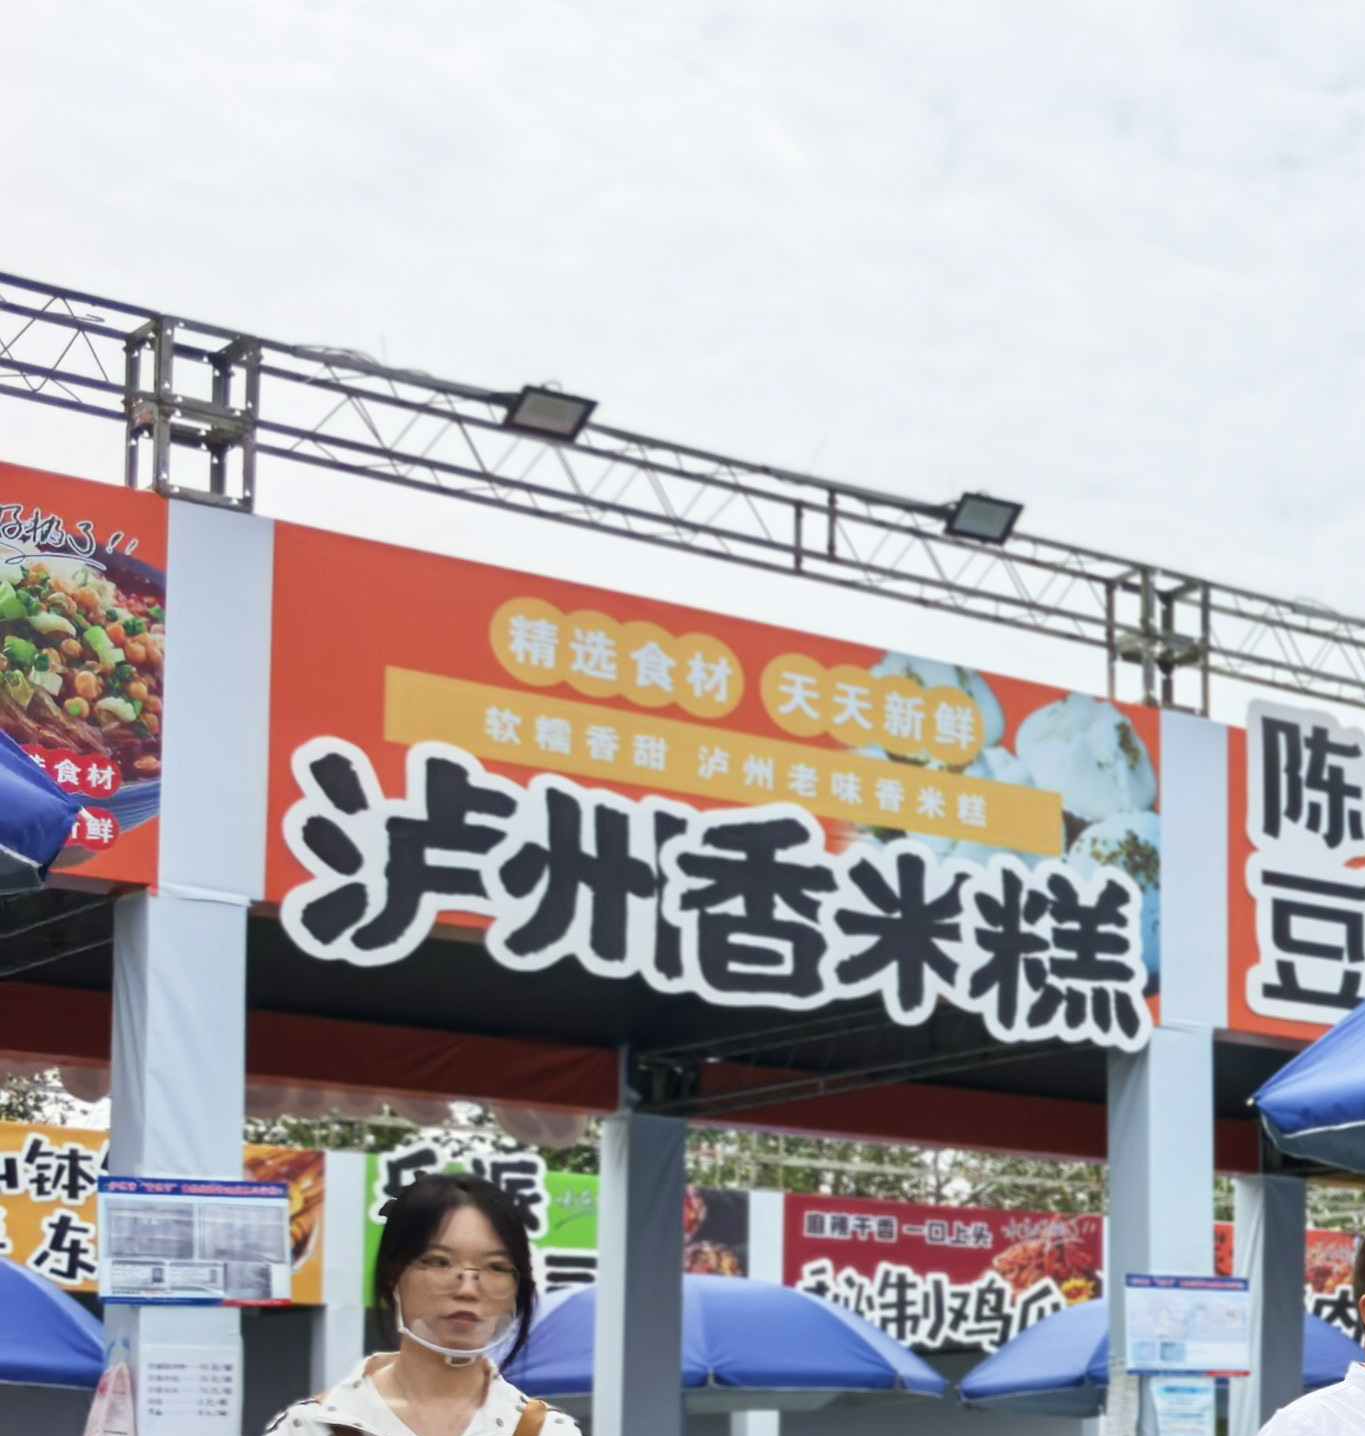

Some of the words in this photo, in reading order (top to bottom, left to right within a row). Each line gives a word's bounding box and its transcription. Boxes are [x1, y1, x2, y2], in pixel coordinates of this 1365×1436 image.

[508, 613, 732, 704] 精选食材
[778, 673, 976, 750] 天天新鲜
[484, 706, 669, 771] 软糯香甜
[697, 747, 989, 828] 泸州老味香米糕
[298, 748, 1145, 1044] 泸州香米糕
